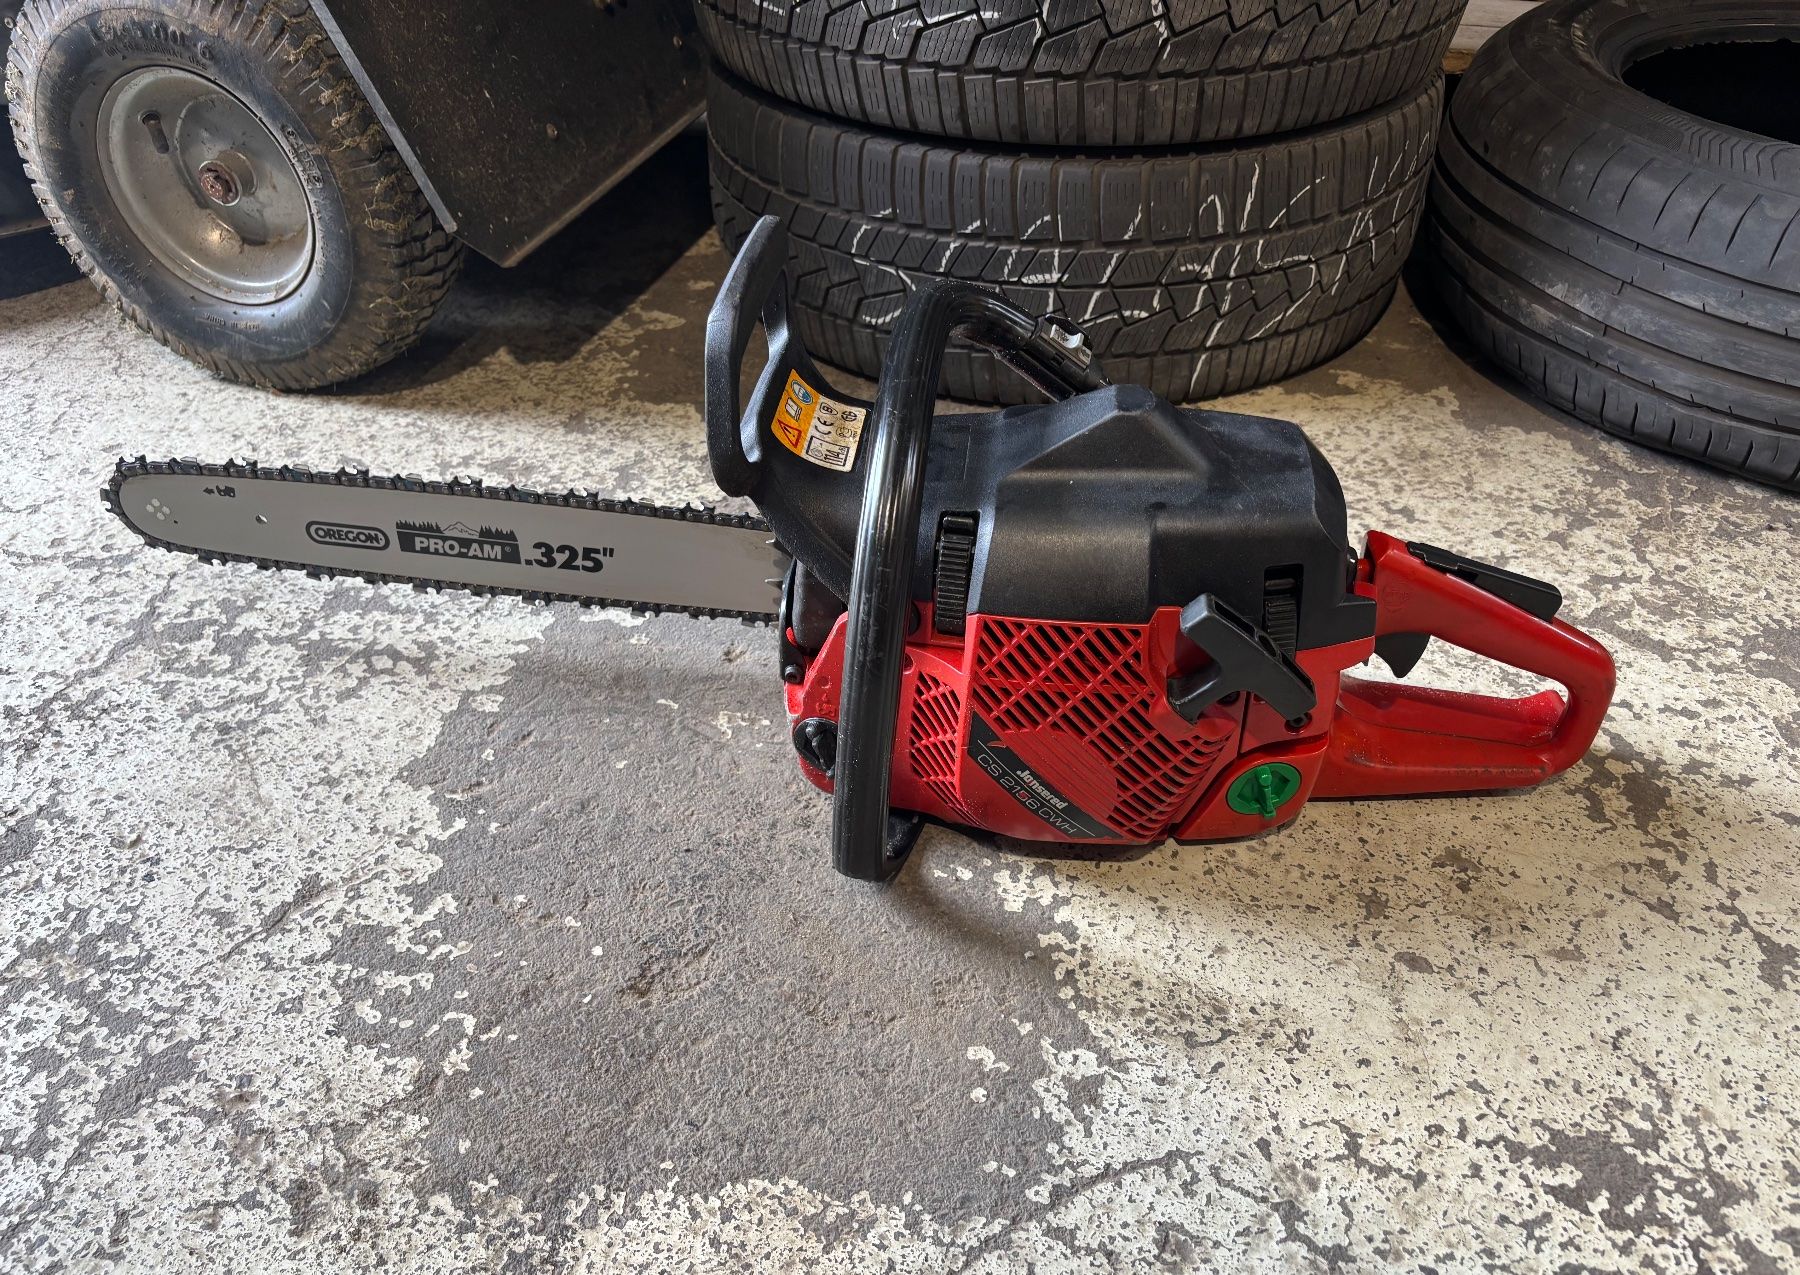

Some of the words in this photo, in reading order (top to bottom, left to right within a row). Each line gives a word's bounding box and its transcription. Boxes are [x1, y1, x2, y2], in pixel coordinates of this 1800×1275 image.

[313, 525, 383, 545] OREGON
[523, 541, 616, 574] .325"
[977, 753, 1003, 777] CS
[999, 776, 1041, 810] 2156
[1038, 807, 1078, 834] CWH
[1016, 769, 1069, 810] Jonsered
